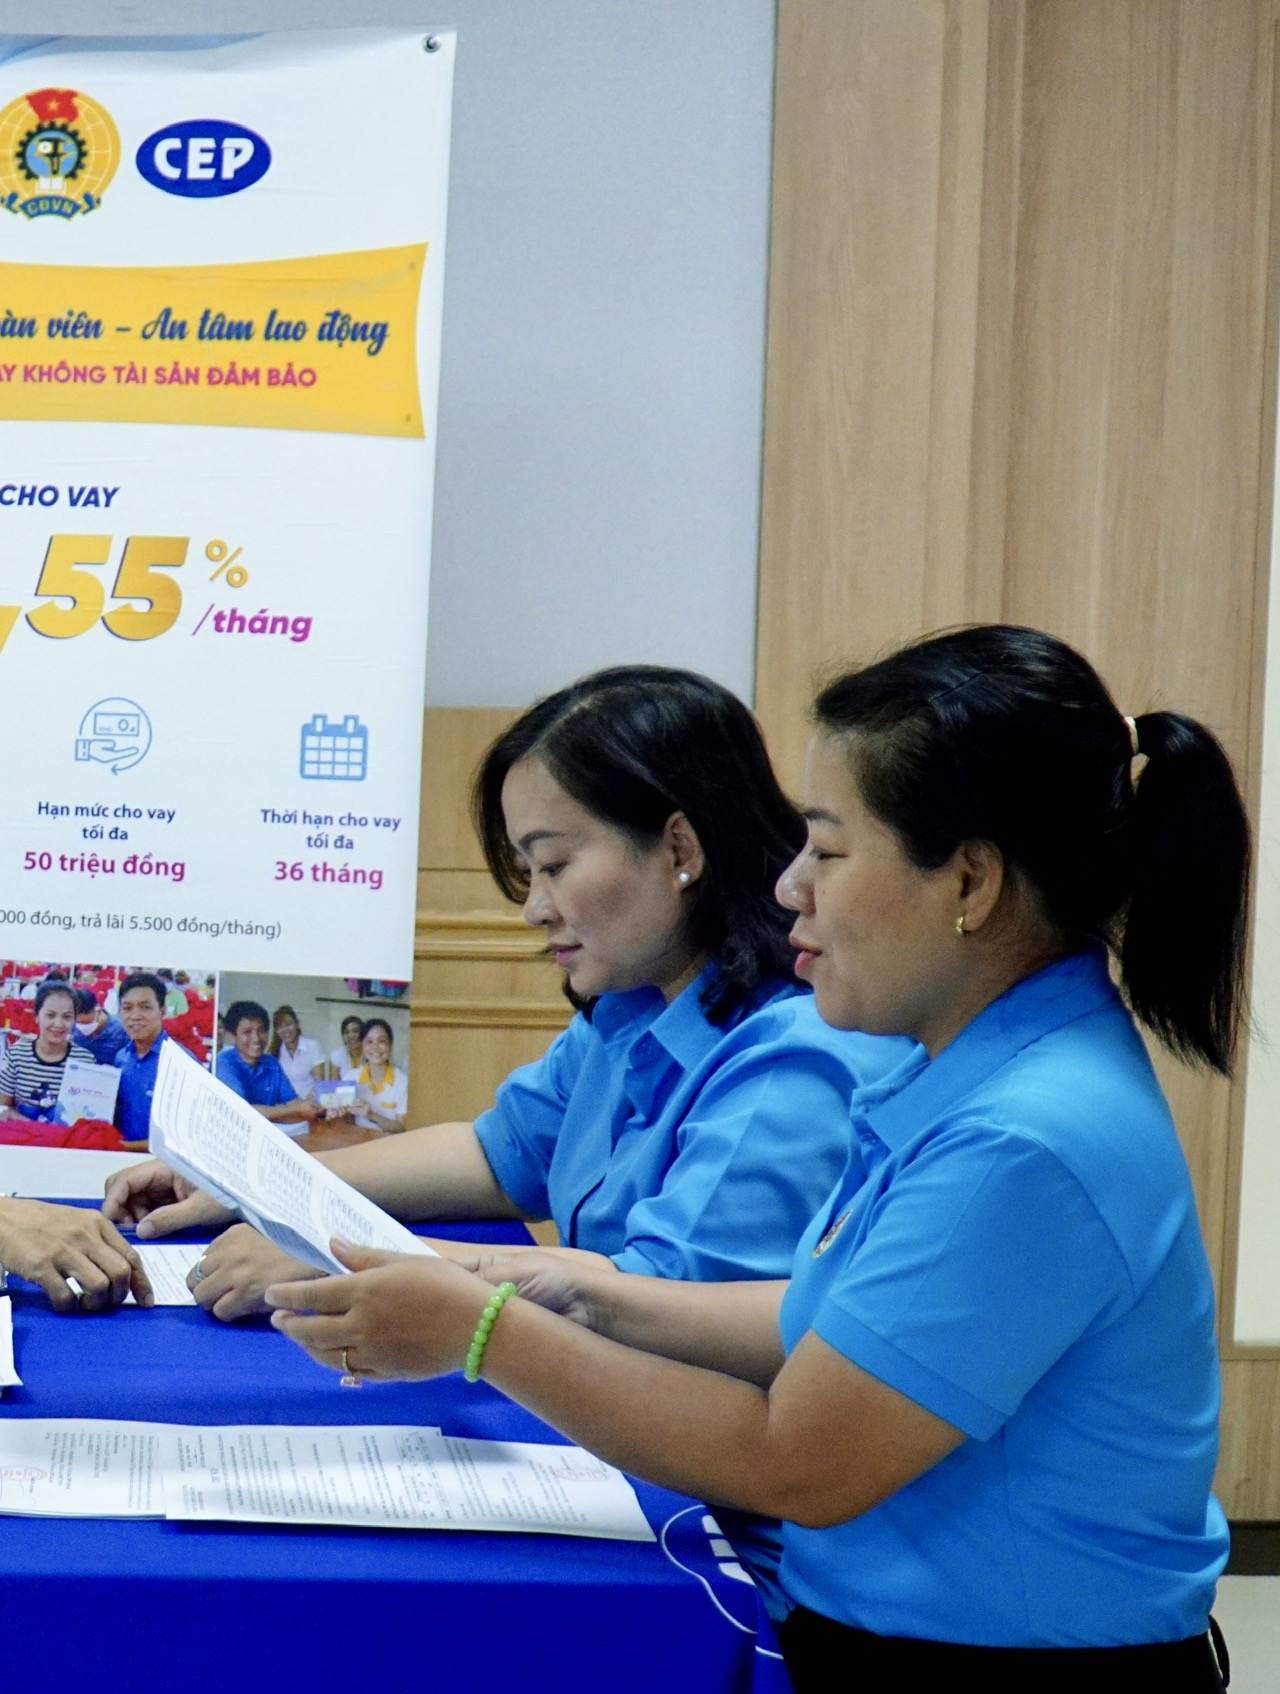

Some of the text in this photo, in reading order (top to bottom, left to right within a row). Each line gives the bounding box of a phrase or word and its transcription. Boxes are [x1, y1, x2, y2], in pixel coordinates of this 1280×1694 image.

[153, 136, 256, 180] CEP
[48, 311, 101, 338] viên
[142, 308, 187, 340] An
[198, 309, 253, 340] tâm
[264, 309, 307, 341] lao
[317, 310, 388, 356] động
[23, 361, 106, 383] KHÔNG
[113, 362, 147, 384] TÀI
[154, 361, 200, 386] SẢN
[207, 362, 260, 386] ĐẢM
[267, 363, 317, 387] BẢO
[69, 487, 119, 507] VAY
[205, 540, 248, 588] %
[193, 604, 312, 642] /tháng
[37, 801, 175, 823] Hạn mức cho vay
[260, 808, 400, 831] Thời hạn cho vay
[82, 824, 128, 840] tối đa
[306, 832, 354, 850] tối đa
[24, 852, 185, 882] 50 triệu đồng
[275, 862, 383, 890] 36 tháng
[81, 913, 101, 927] trả
[107, 914, 124, 928] lãi
[130, 916, 172, 931] 5.500
